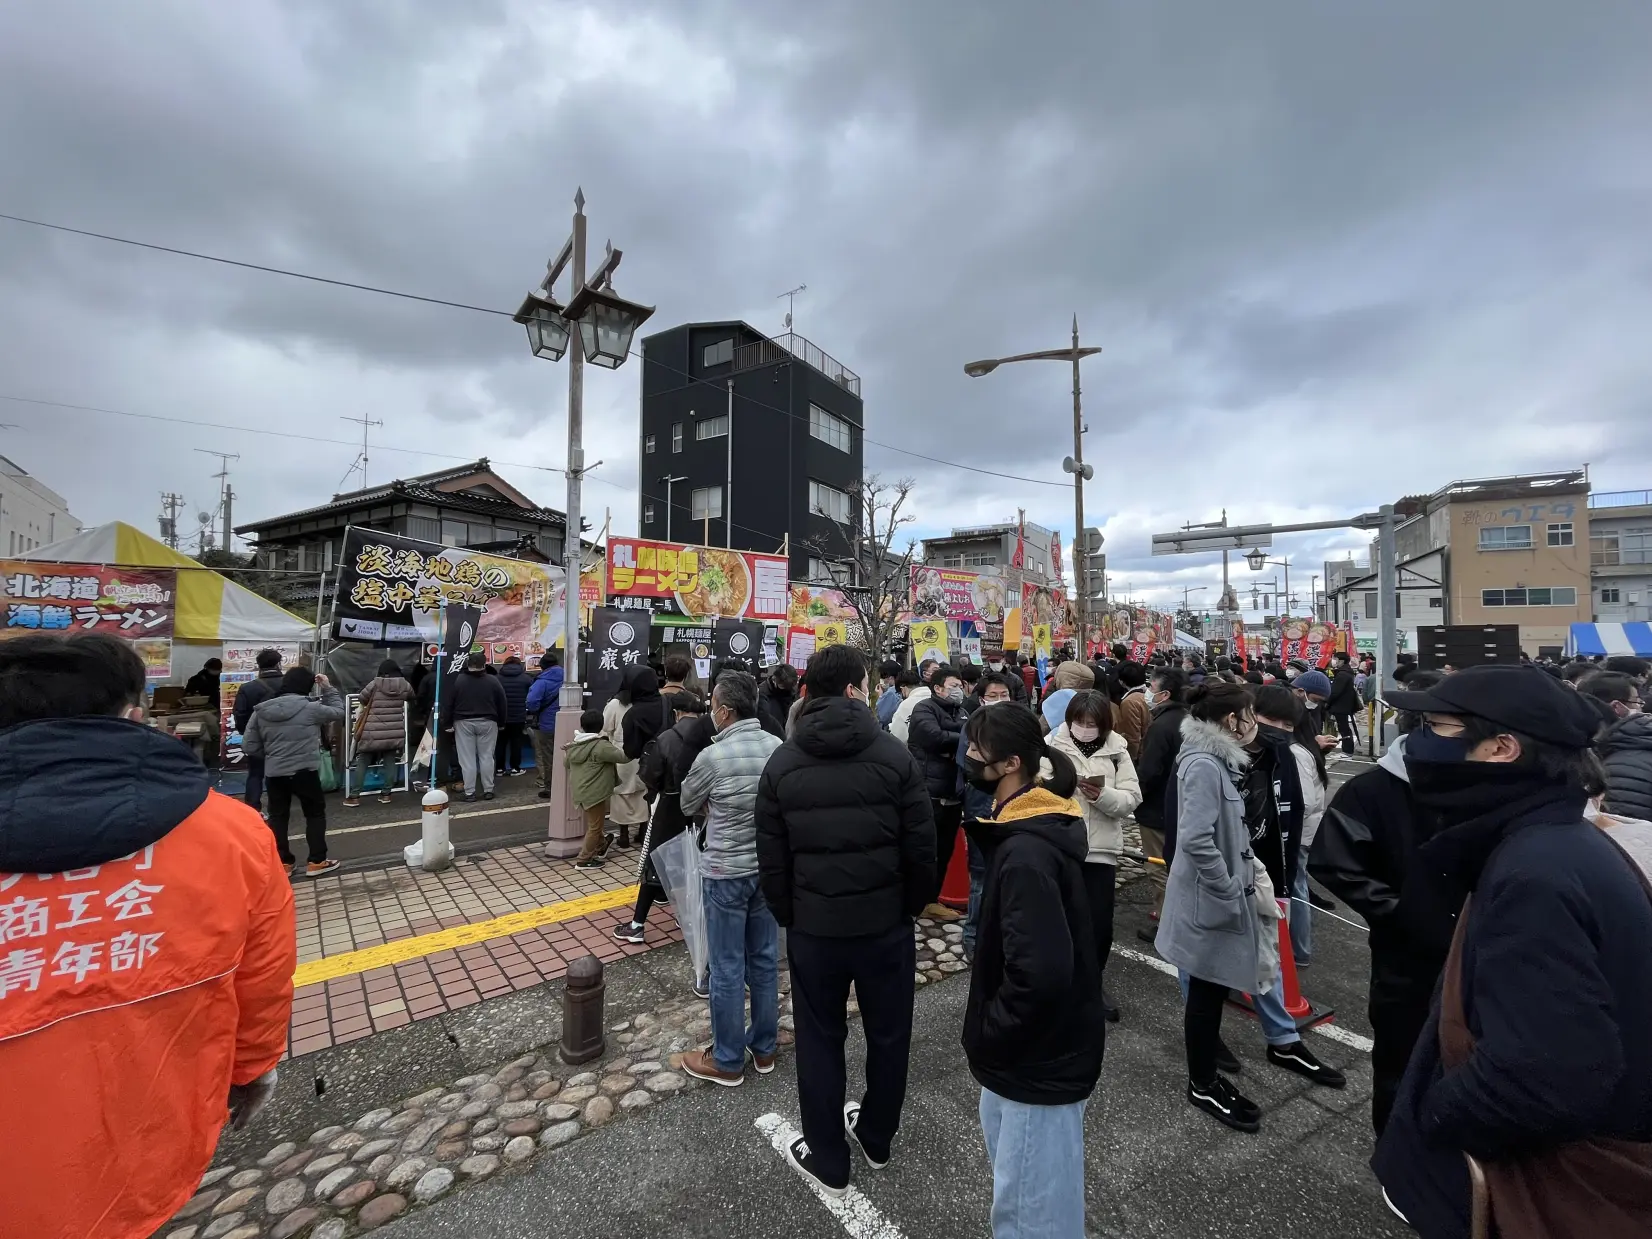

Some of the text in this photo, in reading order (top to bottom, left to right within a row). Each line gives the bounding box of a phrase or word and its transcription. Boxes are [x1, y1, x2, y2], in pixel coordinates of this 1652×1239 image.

[356, 545, 509, 588] 淡海地鶏の
[613, 544, 698, 573] 札幌味噌
[6, 573, 99, 600] 北海道
[613, 567, 698, 594] ラーメン
[7, 604, 168, 629] 海鮮ラーメン
[0, 879, 165, 944] 商工会
[0, 931, 165, 1000] 青年部
